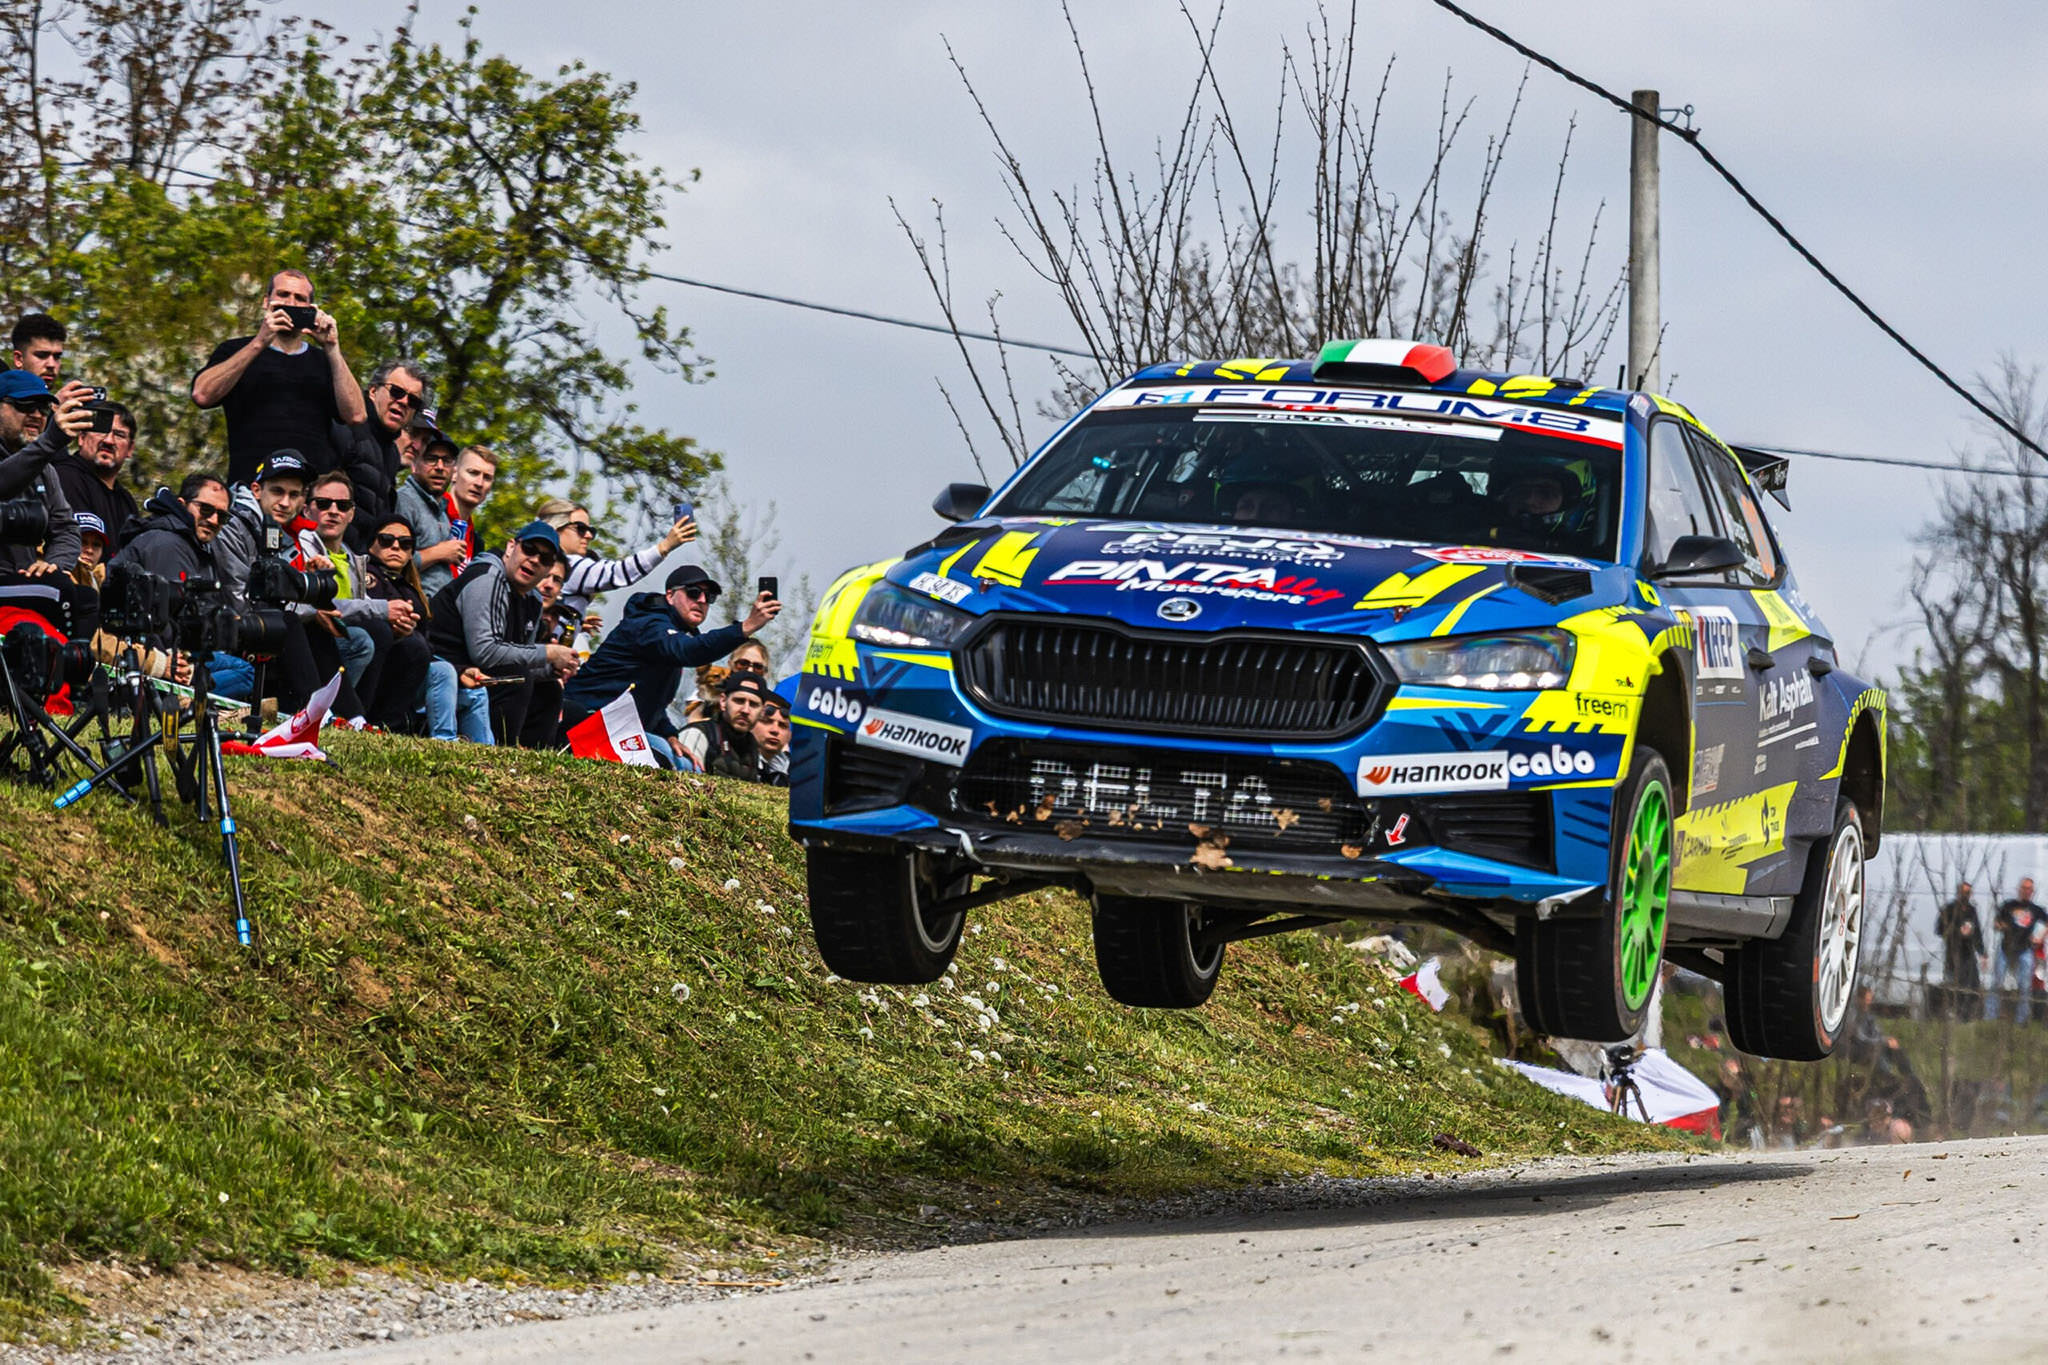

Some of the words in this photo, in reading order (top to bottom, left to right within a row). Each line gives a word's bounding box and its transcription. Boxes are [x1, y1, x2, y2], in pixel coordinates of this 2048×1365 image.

[1203, 388, 1592, 433] FORUM8
[1256, 413, 1338, 423] DELTA
[1048, 558, 1277, 588] PINTA
[1116, 576, 1307, 605] Motorsport
[808, 686, 863, 724] cabo
[1575, 691, 1629, 720] freem
[1507, 743, 1597, 778] cabo
[1028, 759, 1277, 826] DELTA
